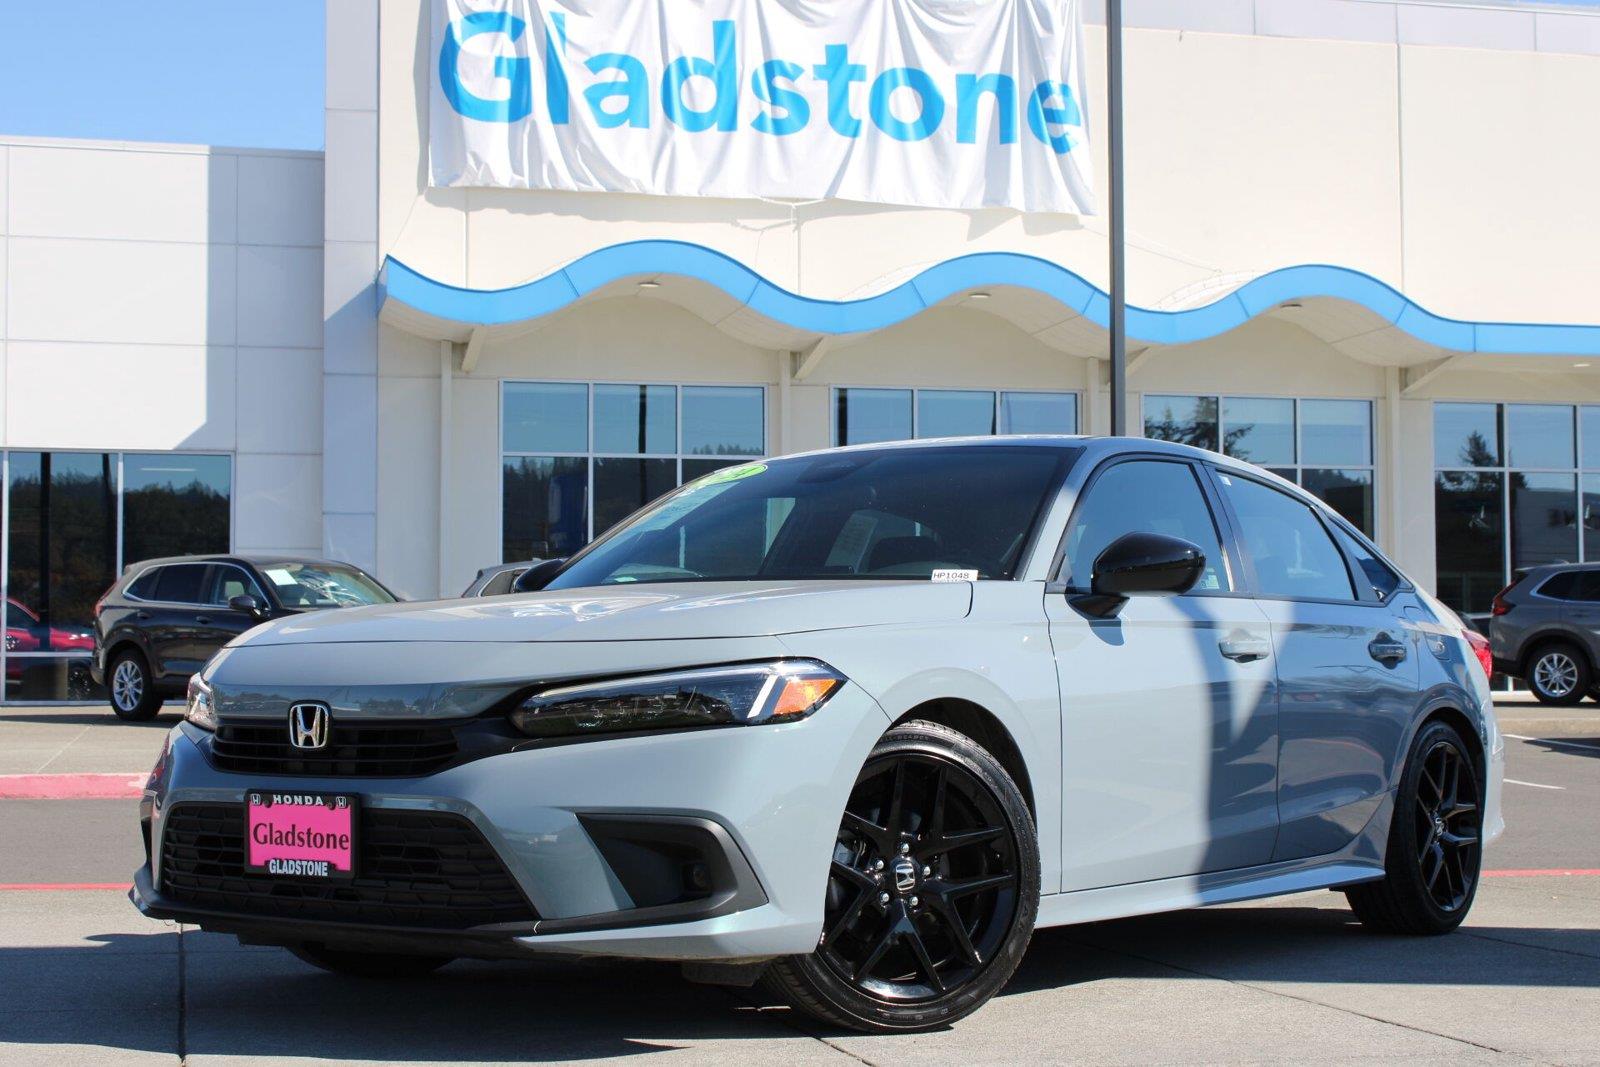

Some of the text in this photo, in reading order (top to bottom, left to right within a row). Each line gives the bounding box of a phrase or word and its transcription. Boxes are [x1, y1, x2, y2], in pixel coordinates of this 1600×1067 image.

[440, 11, 1082, 155] Gladstone
[273, 795, 323, 806] HONDA
[253, 823, 349, 850] Gladstone
[269, 860, 328, 876] GLADSTONE
